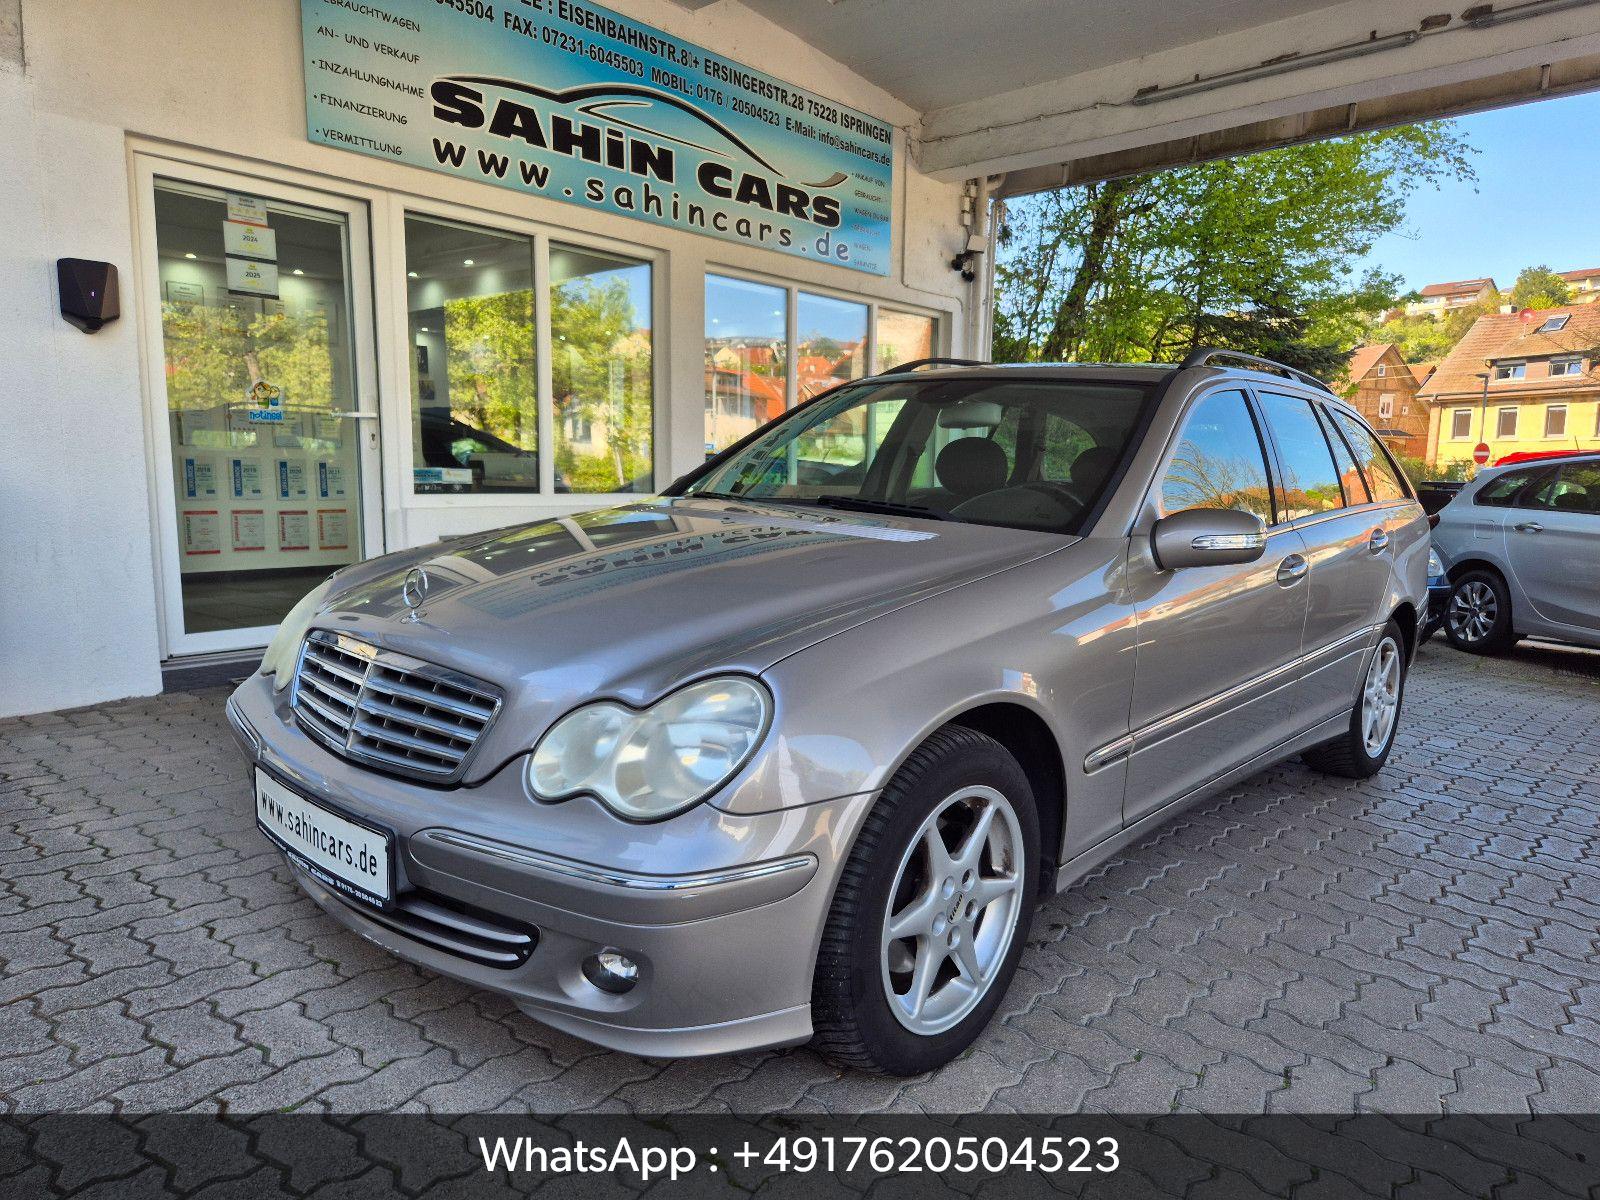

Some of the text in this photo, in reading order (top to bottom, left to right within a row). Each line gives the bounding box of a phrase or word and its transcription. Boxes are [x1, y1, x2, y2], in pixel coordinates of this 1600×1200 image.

[317, 26, 421, 65] AN- UND VERKAUF
[318, 60, 425, 99] INZAHLUNGNAHME
[503, 11, 538, 40] FAX:
[542, 26, 645, 78] 07231-6045503
[651, 66, 693, 95] MOBIL:
[696, 83, 723, 106] 0176
[731, 96, 780, 126] 20504523
[785, 117, 816, 139] E-Mail:
[818, 129, 890, 167] info@sahincars.de
[320, 94, 408, 126] FINANZIERUNG
[807, 99, 838, 124] 75228
[840, 112, 891, 145] ISPRINGEN
[322, 128, 403, 156] VERMITTLUNG
[697, 162, 841, 228] CARS
[261, 789, 378, 877] www.sahincars.de
